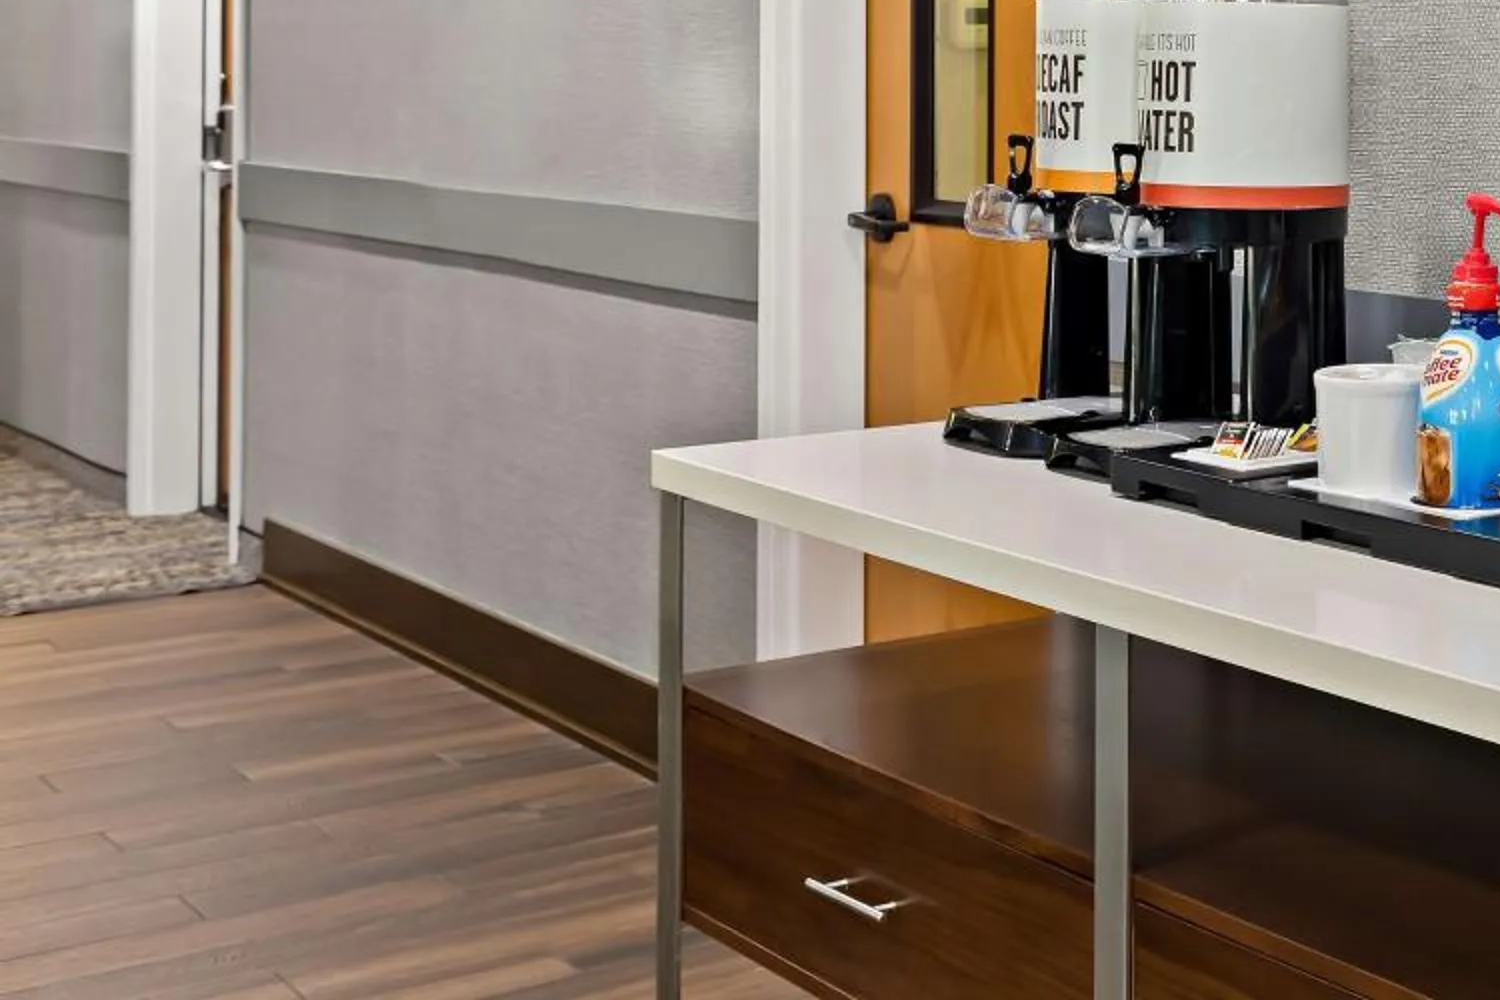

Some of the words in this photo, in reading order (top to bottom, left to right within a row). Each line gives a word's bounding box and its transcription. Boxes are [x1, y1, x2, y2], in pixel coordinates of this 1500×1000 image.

[1038, 54, 1086, 93] ECAF
[1151, 60, 1197, 102] HOT
[1038, 101, 1084, 140] OAST
[1424, 357, 1463, 376] offee
